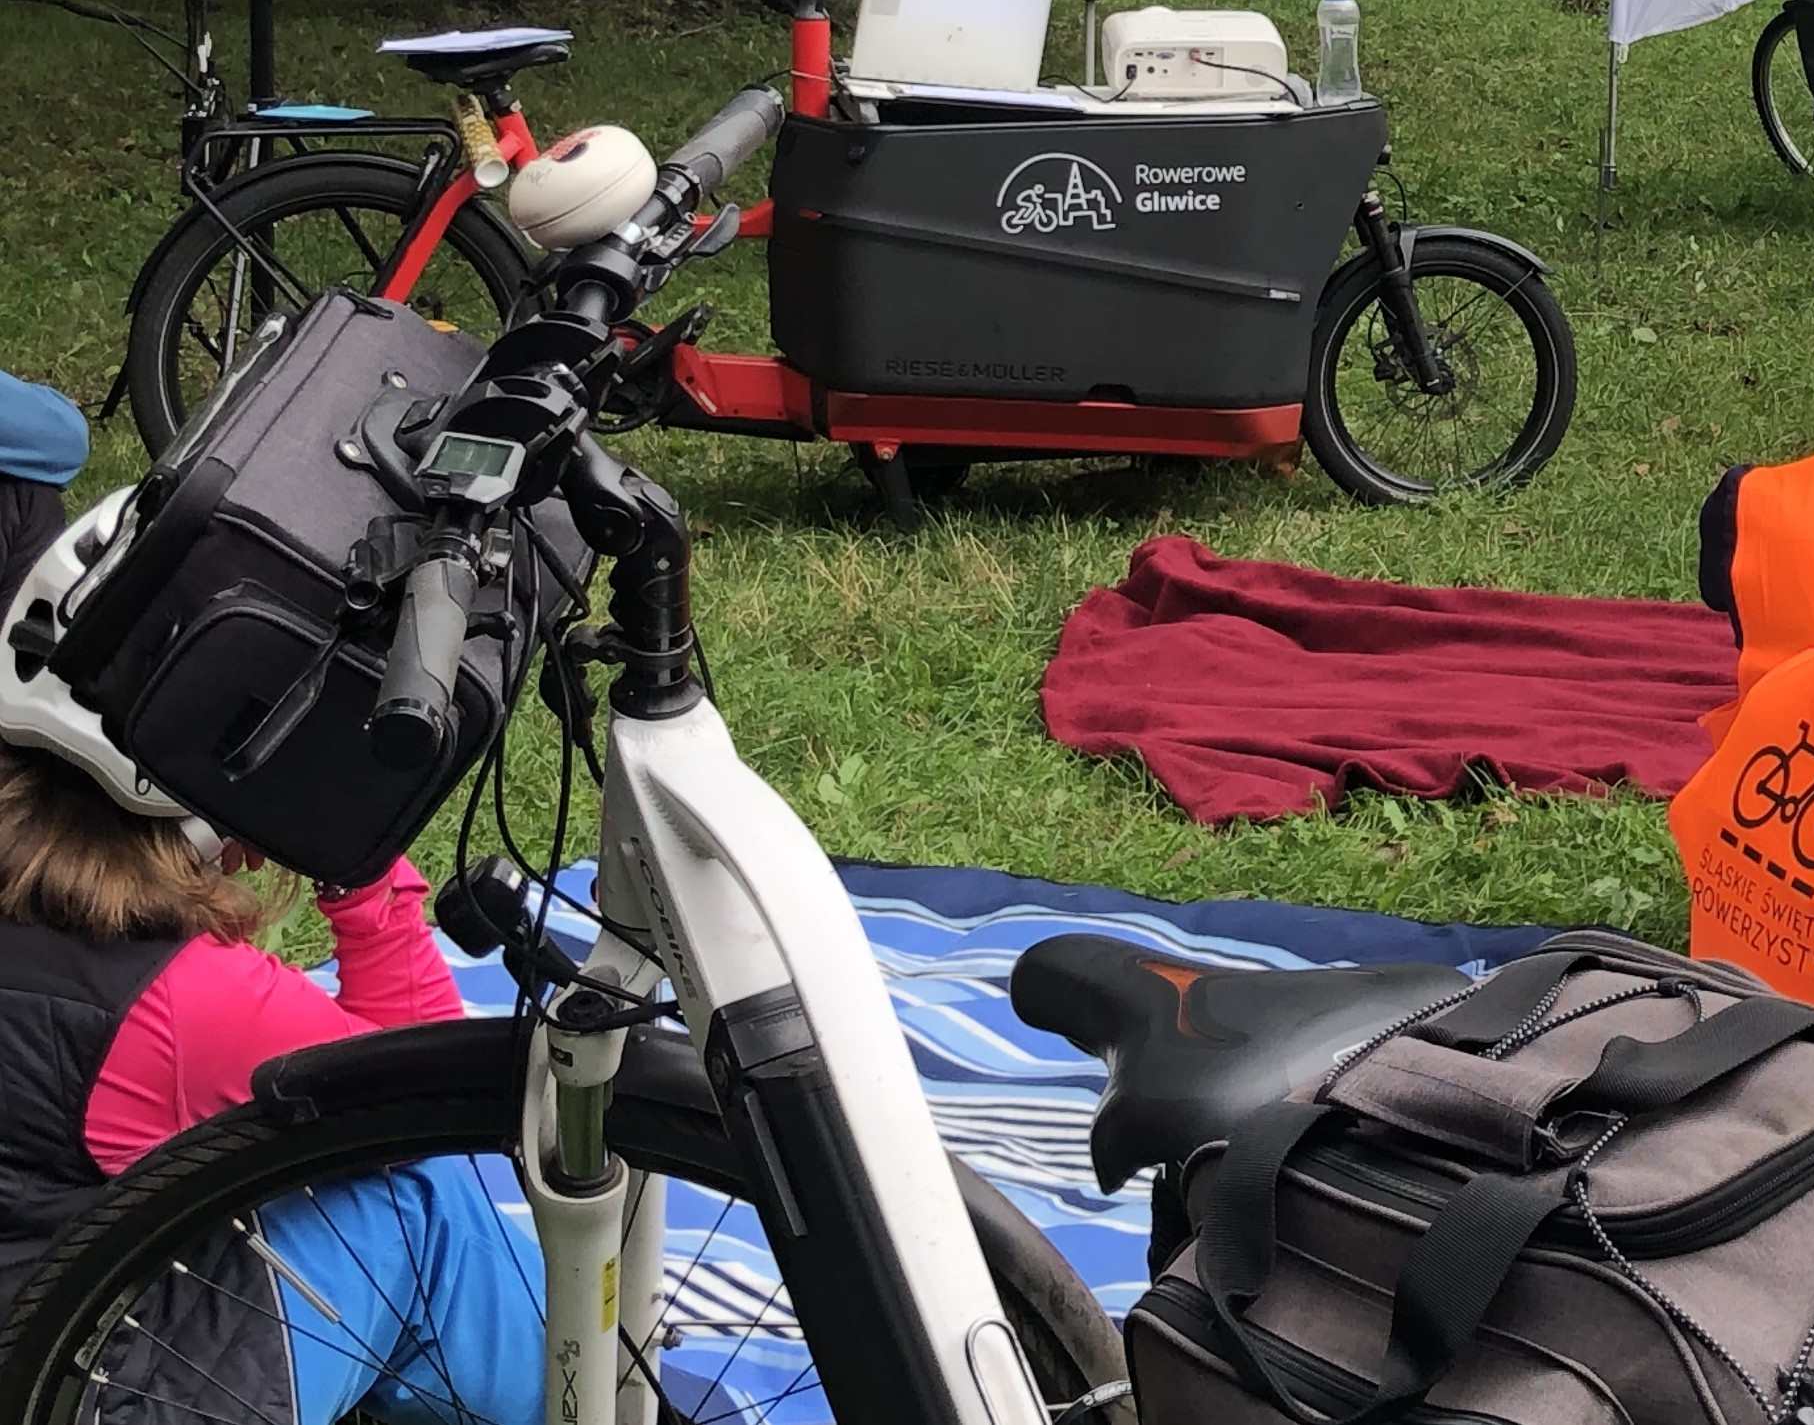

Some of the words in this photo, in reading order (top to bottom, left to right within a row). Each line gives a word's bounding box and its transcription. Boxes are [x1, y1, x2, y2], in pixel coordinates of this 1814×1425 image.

[1134, 163, 1247, 185] Rowerowe
[1134, 190, 1222, 213] Gliwice
[1700, 843, 1757, 905] ŚLĄSKIE
